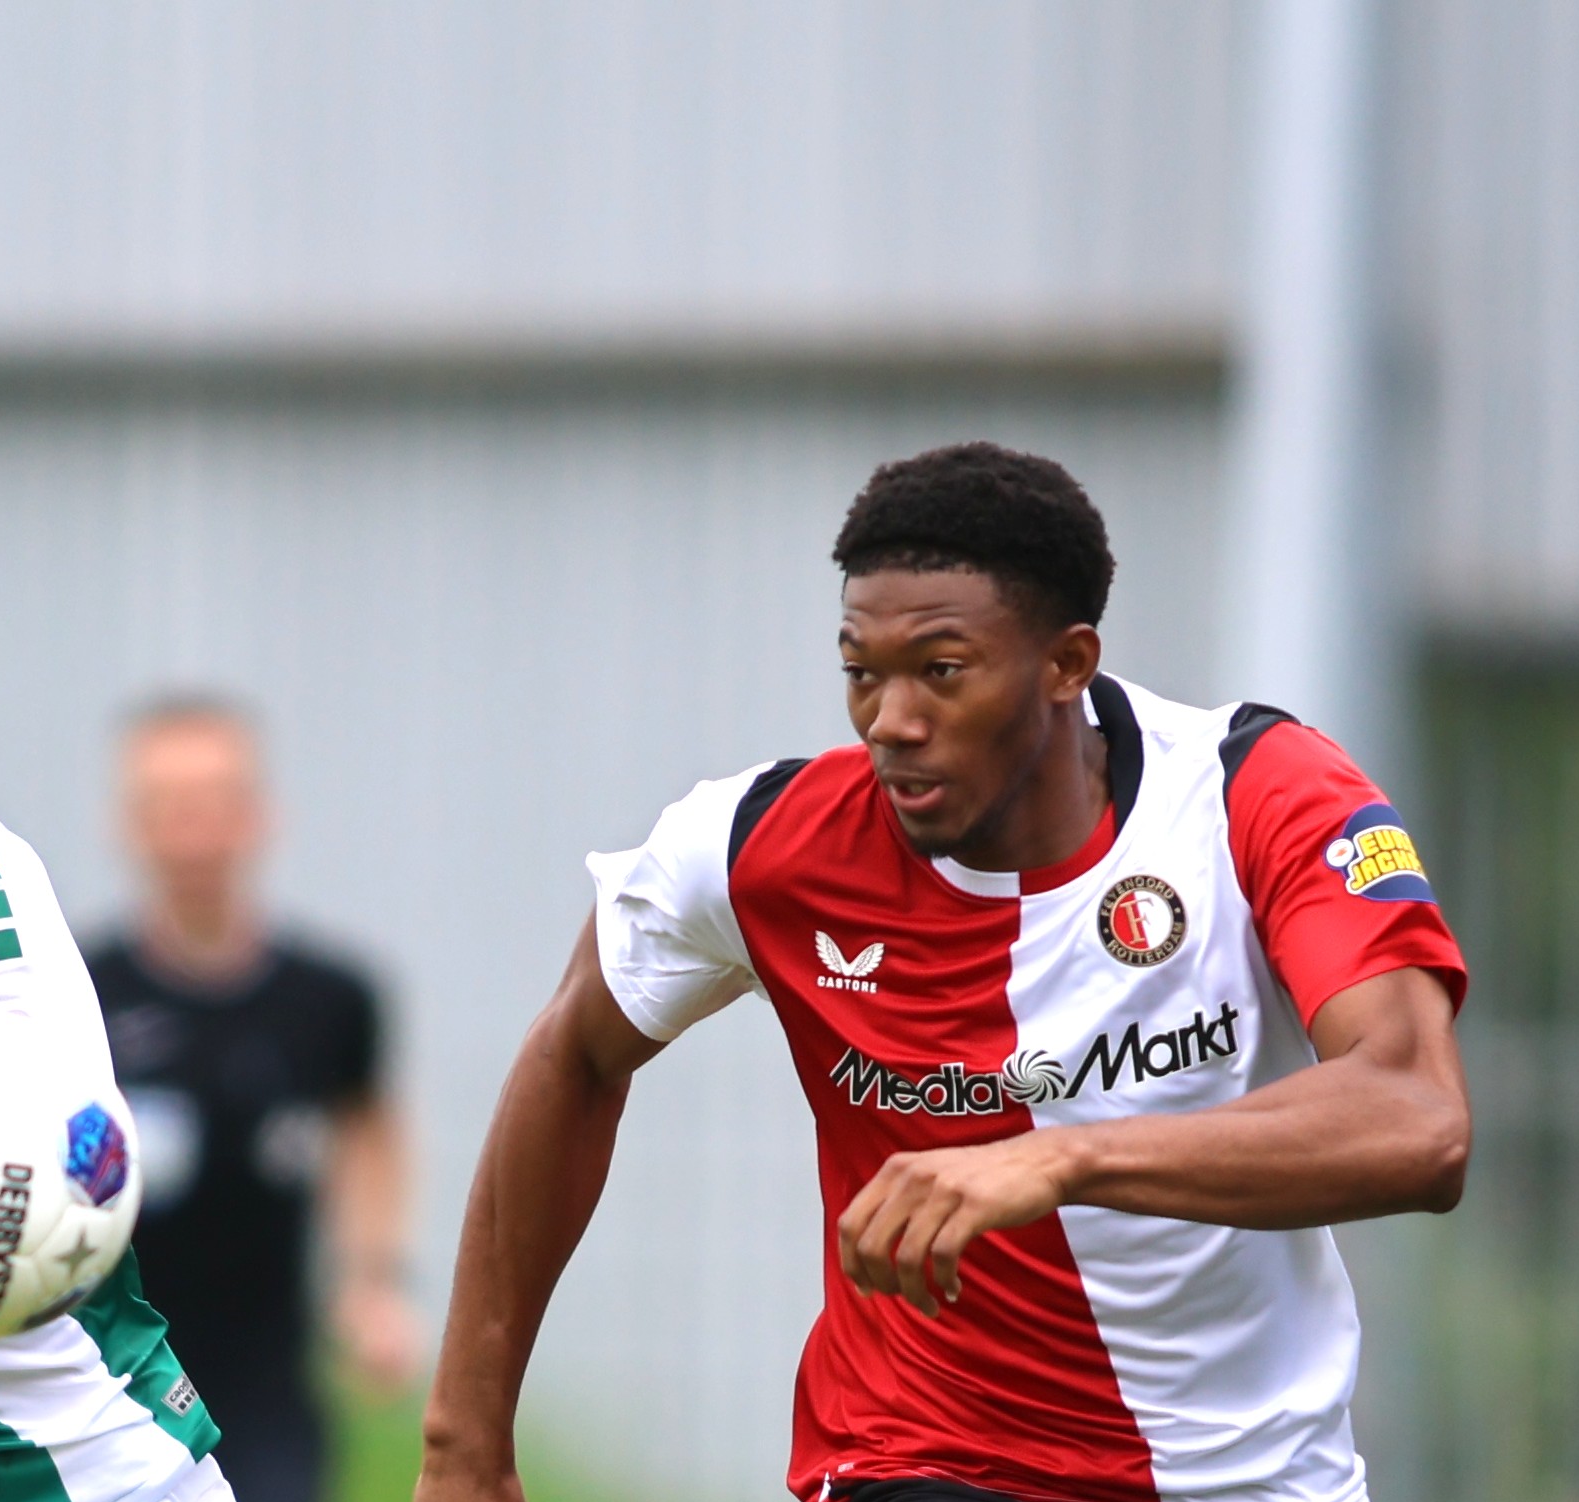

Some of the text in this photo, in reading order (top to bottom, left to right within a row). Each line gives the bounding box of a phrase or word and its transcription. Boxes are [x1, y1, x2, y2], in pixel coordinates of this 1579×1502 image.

[1358, 829, 1416, 858] EUR
[1101, 876, 1175, 917] FEYENOORD
[1107, 922, 1185, 963] ROTTERDAM
[816, 975, 878, 994] CASTORE
[830, 1001, 1240, 1115] Media Markt
